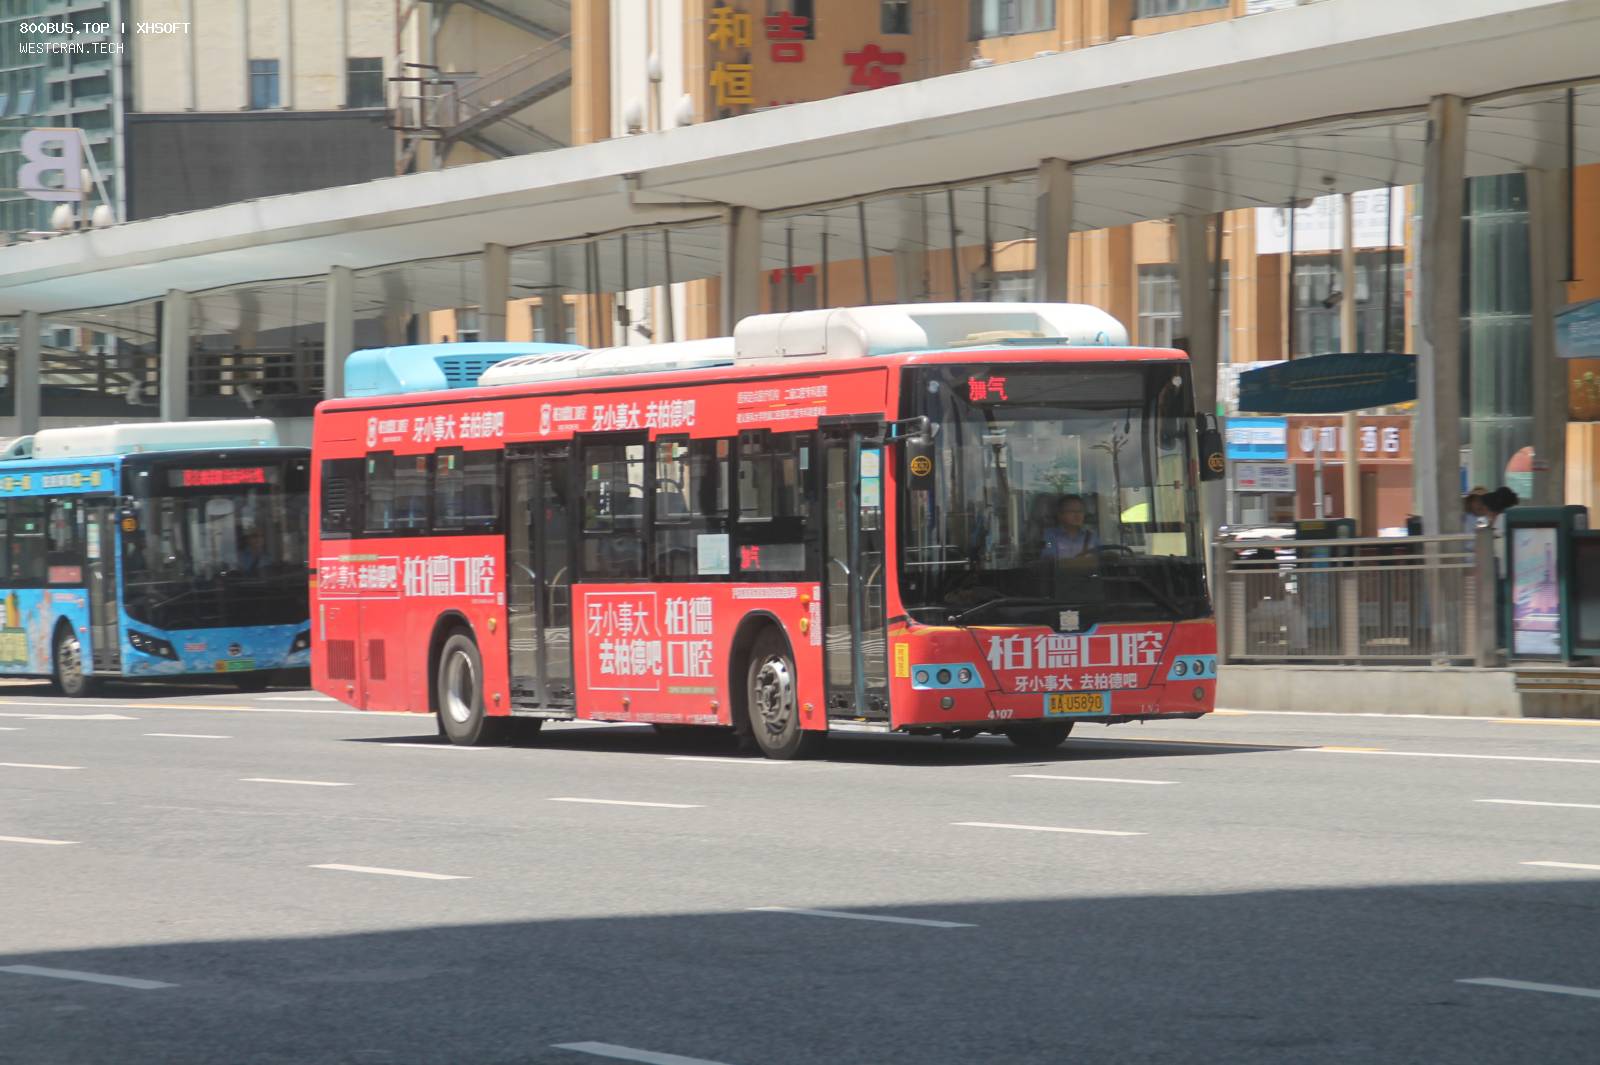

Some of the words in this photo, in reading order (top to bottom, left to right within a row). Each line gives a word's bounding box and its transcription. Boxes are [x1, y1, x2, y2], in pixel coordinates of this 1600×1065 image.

[764, 11, 809, 63] 吉
[591, 402, 641, 431] 牙小事大
[645, 399, 696, 428] 去柏德吧
[403, 555, 495, 597] 柏德口腔
[587, 601, 649, 637] 牙小事大
[664, 596, 713, 635] 柏德
[599, 638, 663, 676] 去柏德吧
[667, 639, 714, 677] 口腔
[986, 631, 1163, 671] 柏德口腔
[1014, 675, 1073, 693] 牙小事大
[1079, 673, 1138, 691] 去柏德吧
